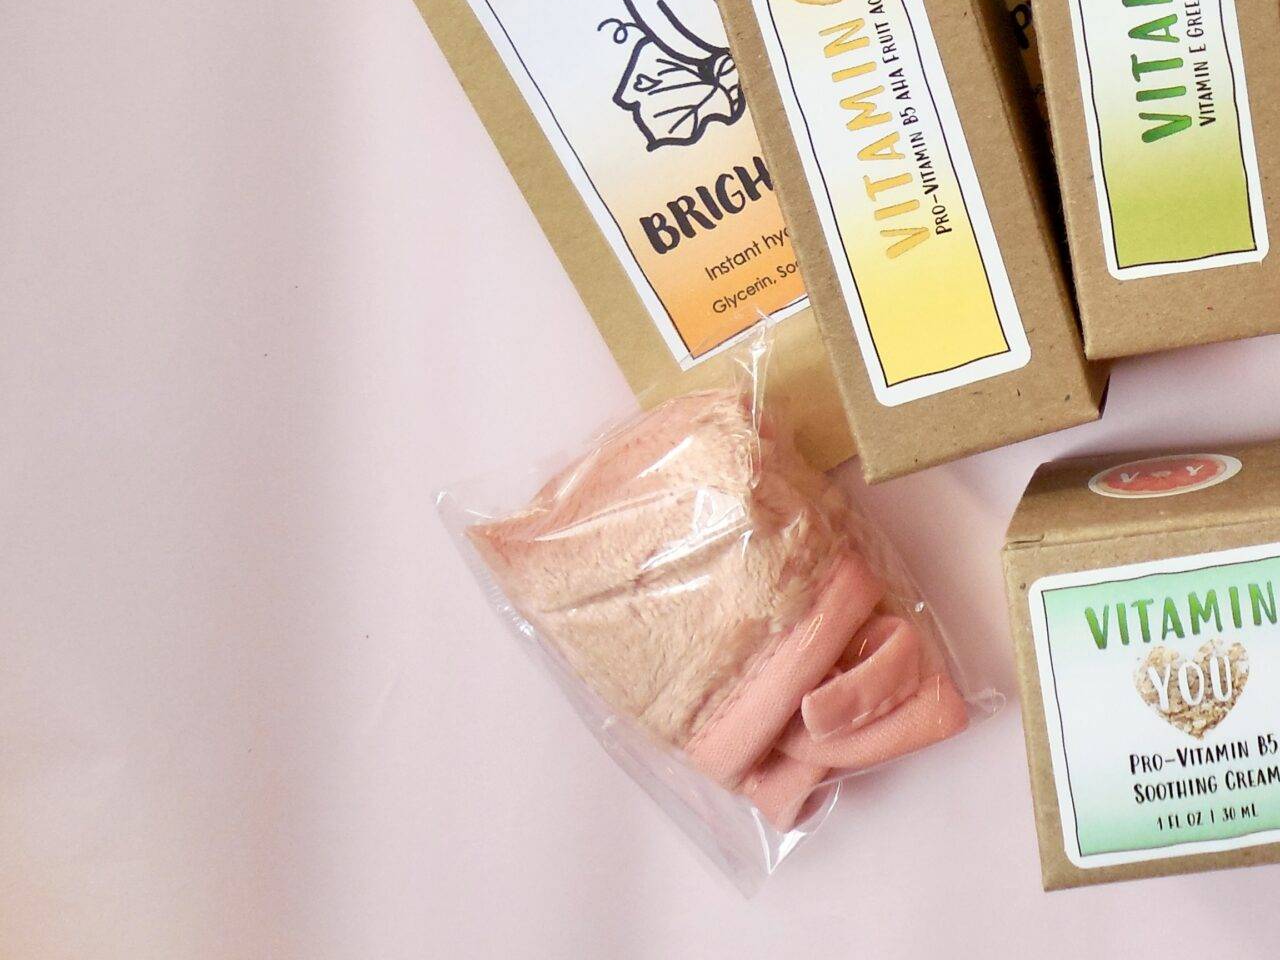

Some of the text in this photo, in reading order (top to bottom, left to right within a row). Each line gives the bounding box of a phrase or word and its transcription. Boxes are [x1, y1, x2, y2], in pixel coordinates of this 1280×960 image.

[875, 20, 900, 67] FRUIT
[1190, 43, 1207, 54] E
[891, 67, 911, 101] AHA
[1196, 59, 1216, 128] VITAMIN
[903, 107, 917, 126] B5
[819, 18, 930, 259] VITAMIN
[910, 131, 952, 235] PRO-VITAMIN
[639, 155, 774, 255] BRIGH
[705, 243, 761, 281] Instant
[712, 274, 777, 313] Glycerin,
[1084, 580, 1278, 711] VITAMIN YOU
[1129, 734, 1278, 774] PRO-VITAMIN B5
[1133, 765, 1280, 803] SOOTHING CREAM
[1157, 817, 1164, 830] 1
[1168, 814, 1181, 829] FL
[1187, 812, 1203, 827] OZ
[1222, 807, 1237, 821] 30
